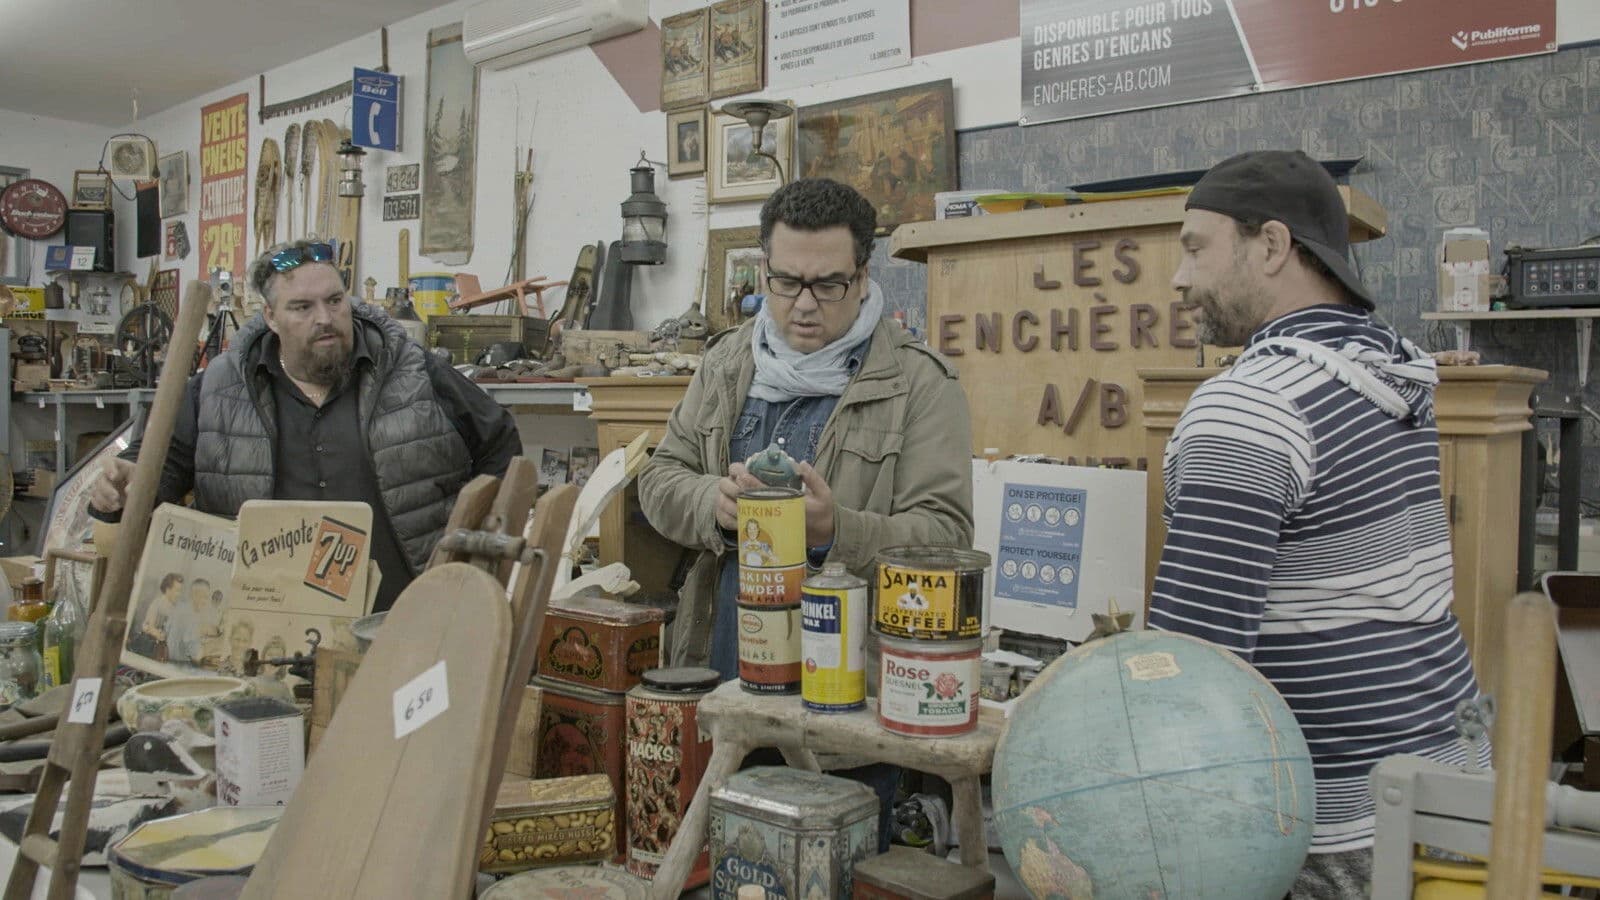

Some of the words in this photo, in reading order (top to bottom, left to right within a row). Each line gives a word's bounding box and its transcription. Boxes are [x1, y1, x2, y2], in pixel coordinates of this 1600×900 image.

[1034, 10, 1120, 46] DISPONIBLE
[1125, 4, 1166, 29] POUR
[1173, 0, 1212, 21] TOUS
[1471, 24, 1540, 41] Publiforme
[1034, 42, 1090, 70] GENRES
[1096, 27, 1172, 60] D'ENCANS
[361, 85, 387, 96] Bell
[1034, 64, 1171, 106] ENCHERES-AB.COM
[203, 103, 247, 145] VENTE
[202, 137, 246, 178] PNEUS
[1033, 239, 1140, 290] LES
[939, 293, 1198, 357] ENCHÈRE
[1038, 378, 1128, 436] A/B
[1008, 488, 1023, 498] ON
[1024, 490, 1035, 499] SE
[1000, 545, 1035, 557] PROTECT
[1036, 549, 1080, 562] YOURSELF!
[739, 572, 785, 583] AKING
[882, 567, 948, 590] SANKA
[739, 583, 786, 595] OWDER
[882, 605, 947, 618] DECAFFEINATED
[882, 612, 946, 629] COFFEE
[804, 618, 820, 627] WAX
[886, 659, 931, 681] Rose
[885, 676, 923, 691] QUESNEL
[922, 707, 962, 715] TOBACCO
[630, 740, 674, 762] HACKS
[537, 831, 565, 841] MIXED
[568, 829, 591, 839] NUTS
[726, 858, 775, 887] GOLD
